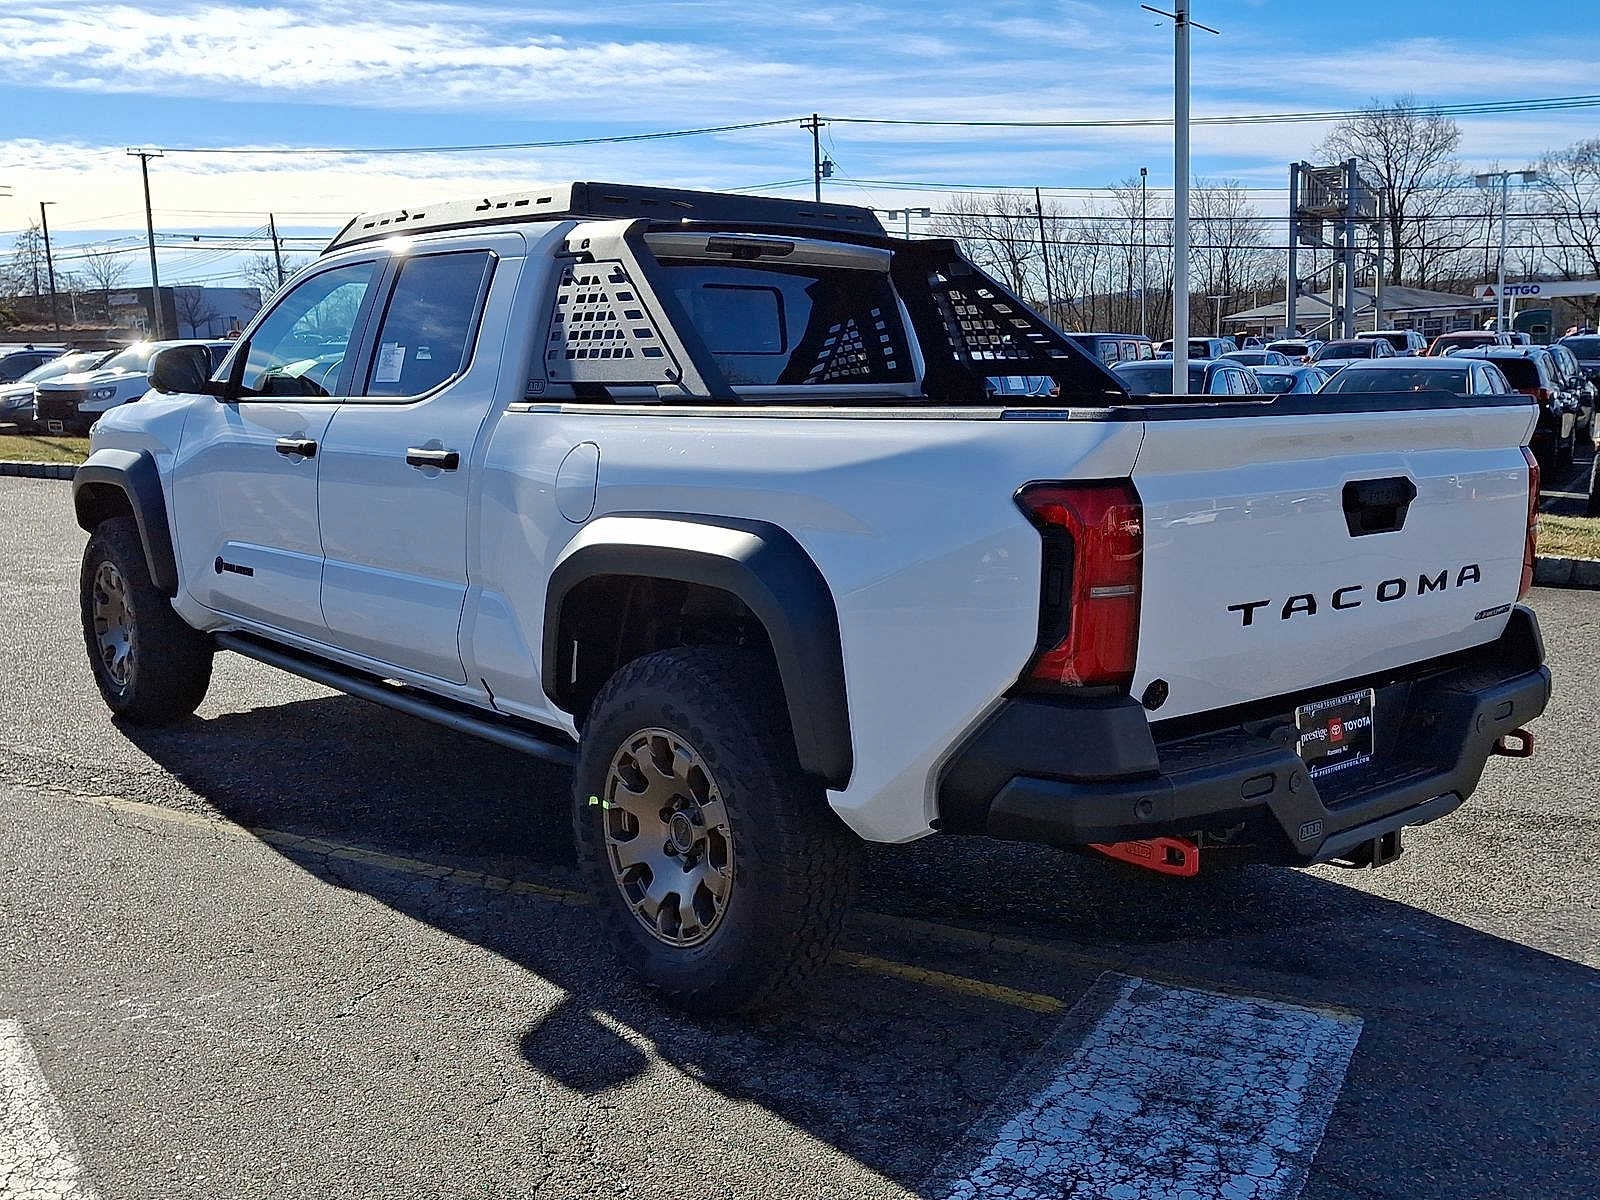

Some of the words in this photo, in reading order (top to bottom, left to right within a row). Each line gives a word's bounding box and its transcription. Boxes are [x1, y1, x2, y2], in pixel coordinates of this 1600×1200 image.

[1504, 285, 1540, 295] CITGO
[1227, 564, 1481, 627] TACOMA
[1301, 727, 1328, 747] prestige
[1343, 716, 1371, 731] TOYOTA
